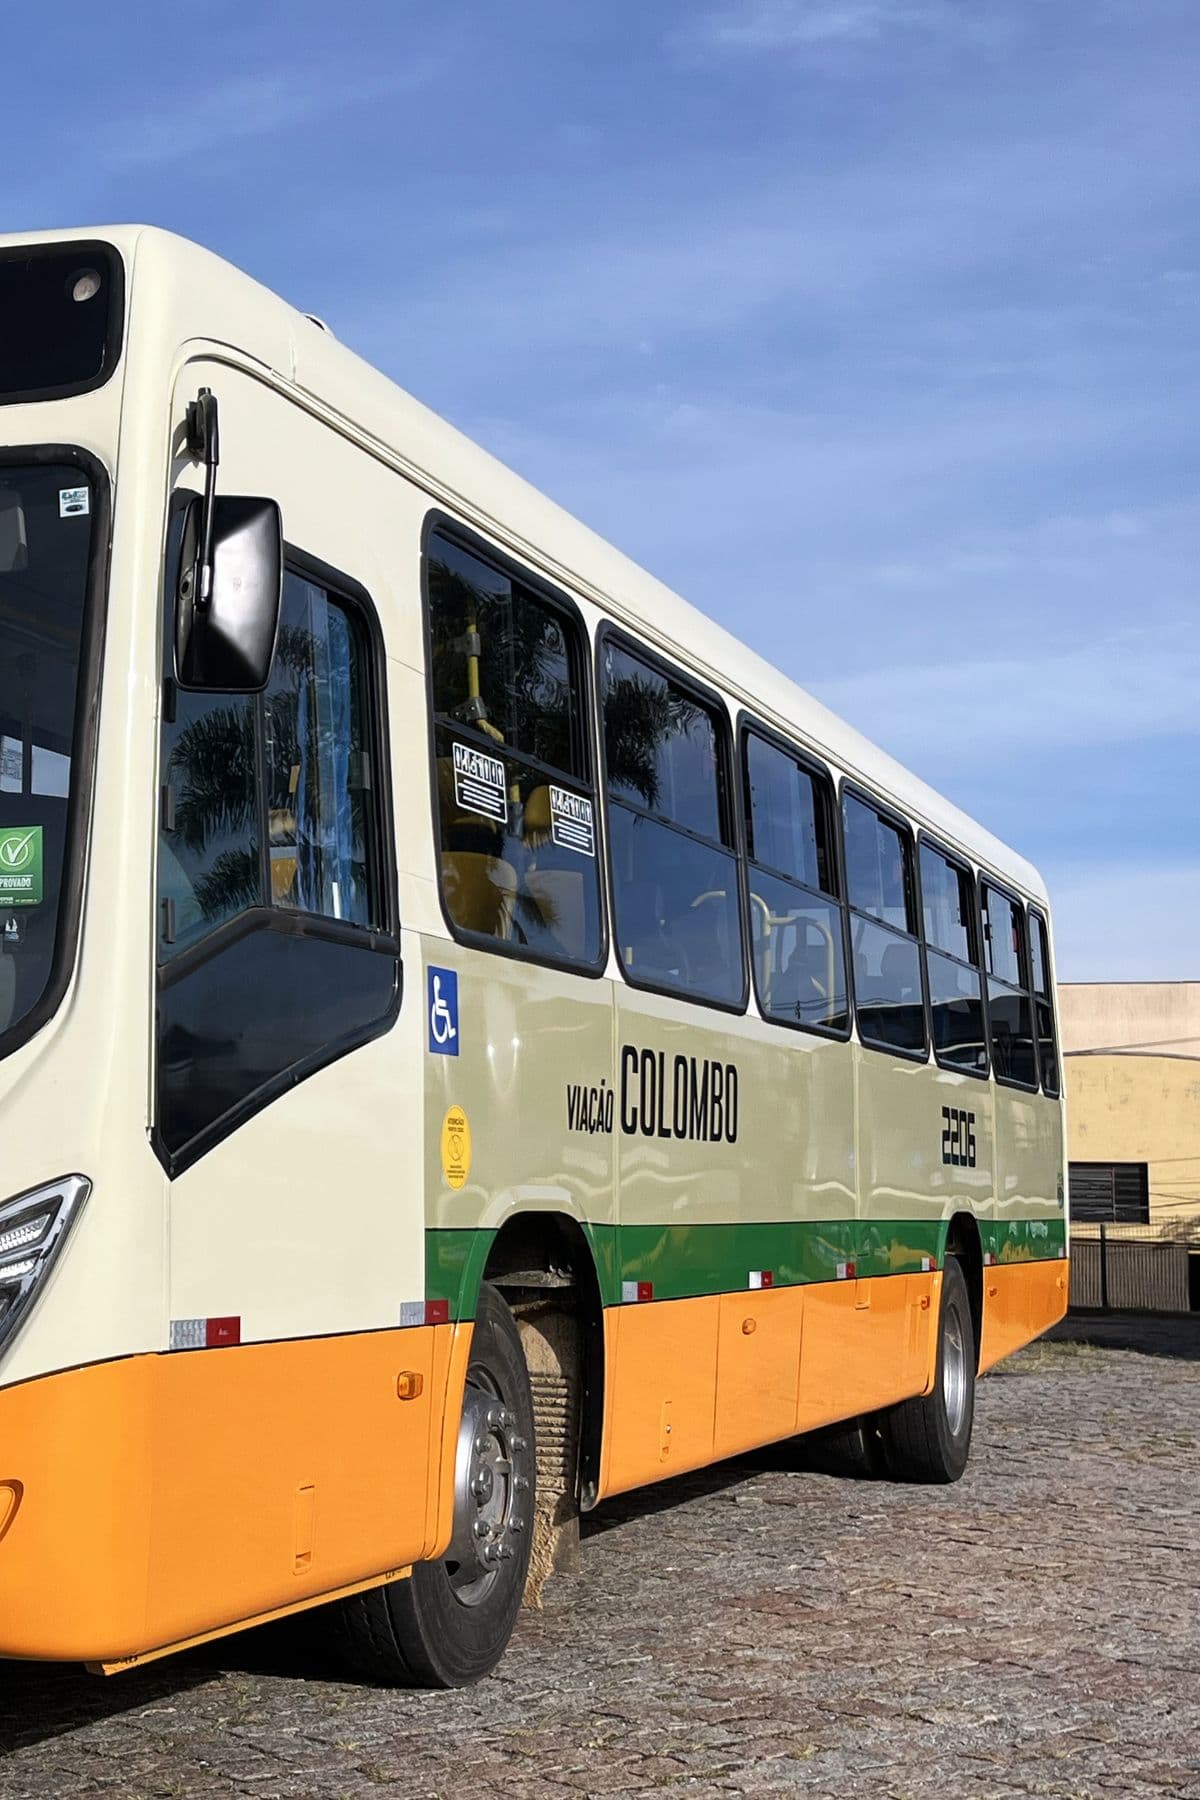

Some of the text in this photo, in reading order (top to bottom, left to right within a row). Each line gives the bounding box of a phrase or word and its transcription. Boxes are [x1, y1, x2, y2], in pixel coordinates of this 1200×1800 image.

[567, 1044, 738, 1144] VIAÇÃO COLOMBO
[942, 1105, 976, 1168] 2206
